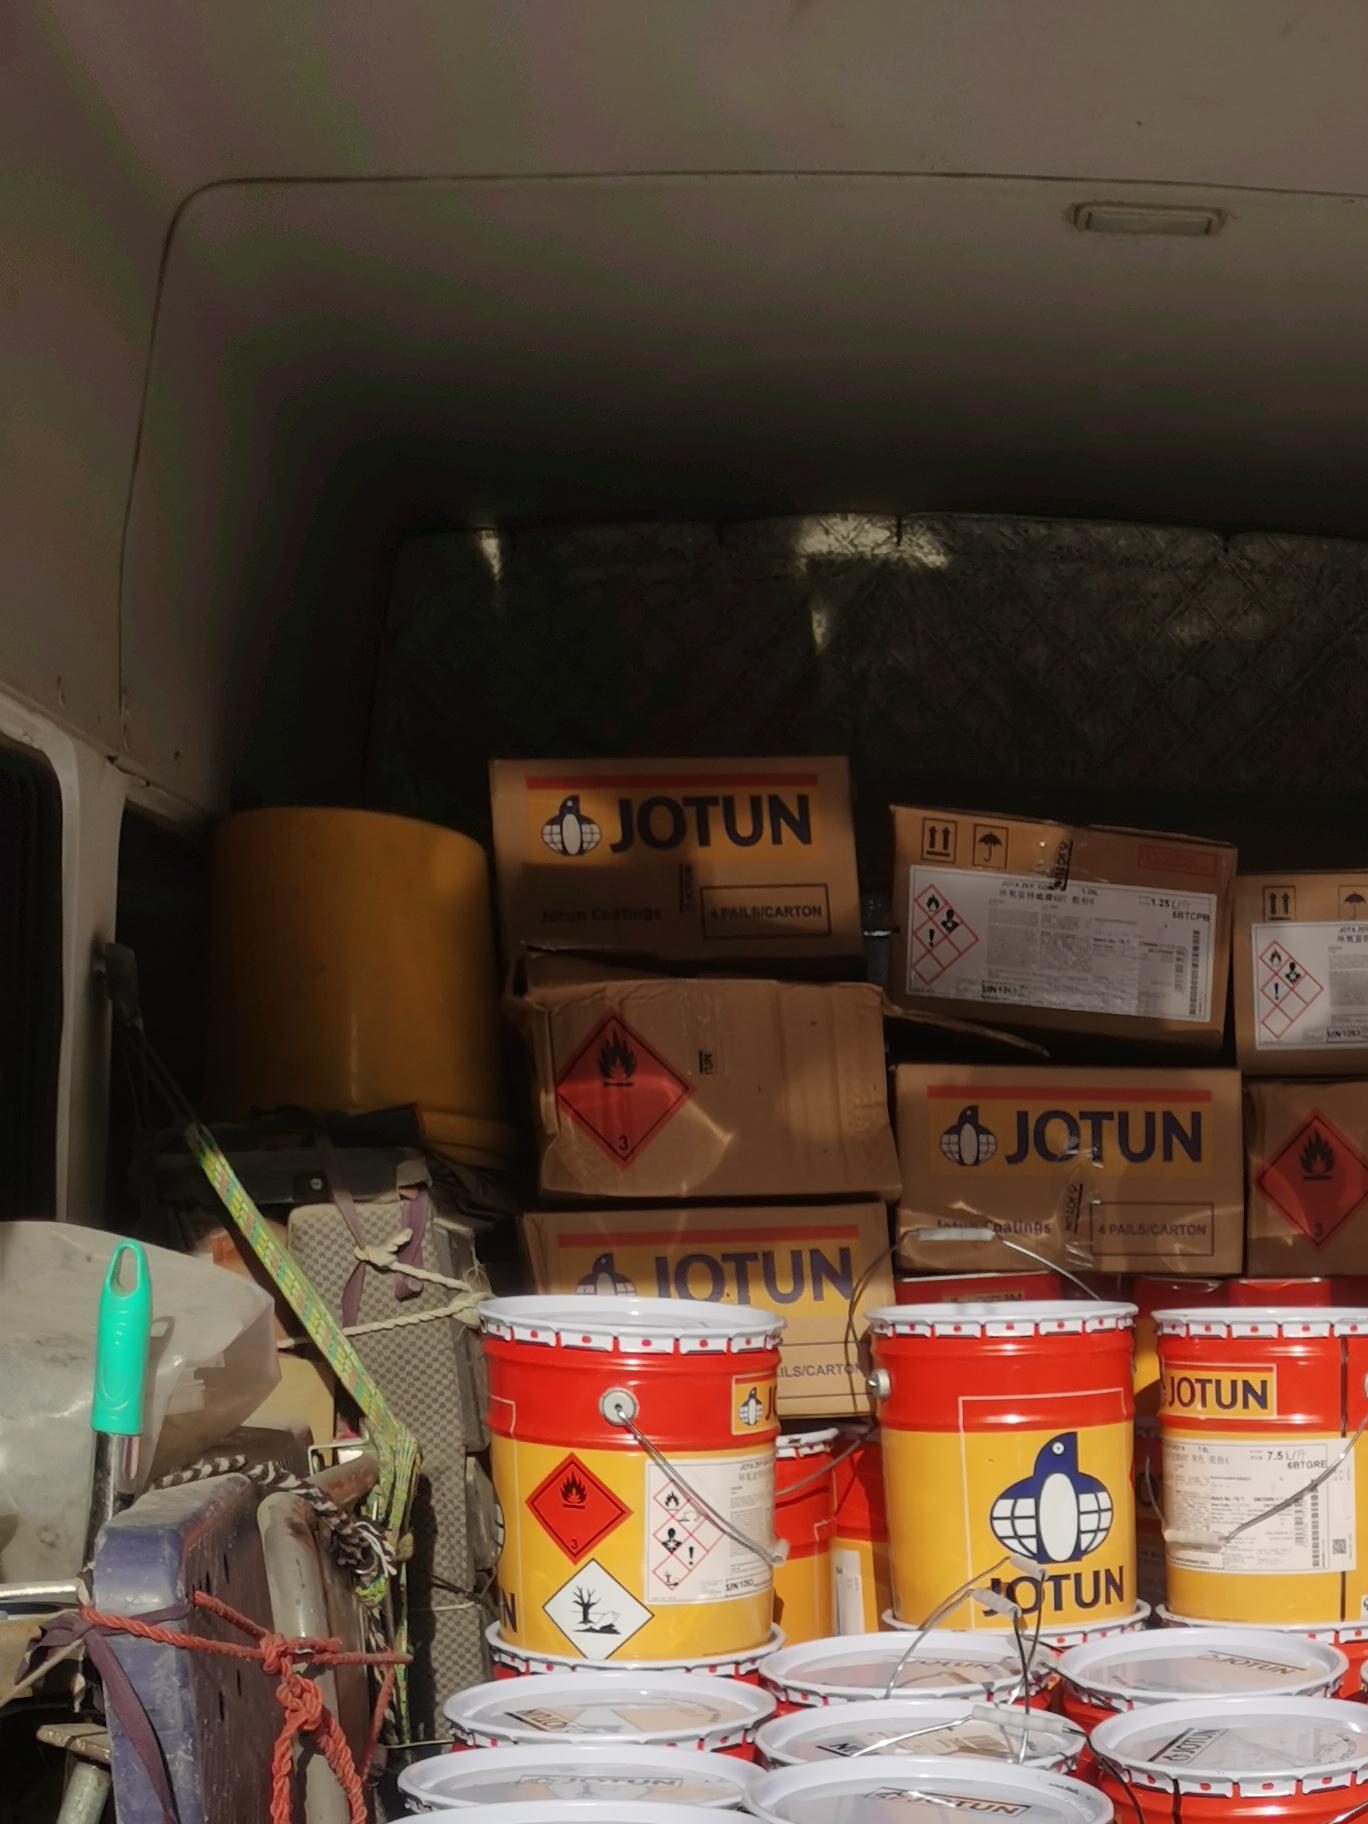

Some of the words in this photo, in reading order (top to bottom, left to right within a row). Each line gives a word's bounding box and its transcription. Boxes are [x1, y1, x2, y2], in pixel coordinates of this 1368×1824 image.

[610, 794, 812, 852] JOTUN
[618, 1135, 629, 1150] 3
[1005, 1110, 1202, 1164] JOTUN
[1110, 1224, 1206, 1236] PAILS/CARTON
[1168, 1376, 1268, 1410] JOTUN
[1267, 1451, 1284, 1461] 7.5
[1288, 1460, 1328, 1469] 6BTGRE
[570, 1539, 578, 1549] 3
